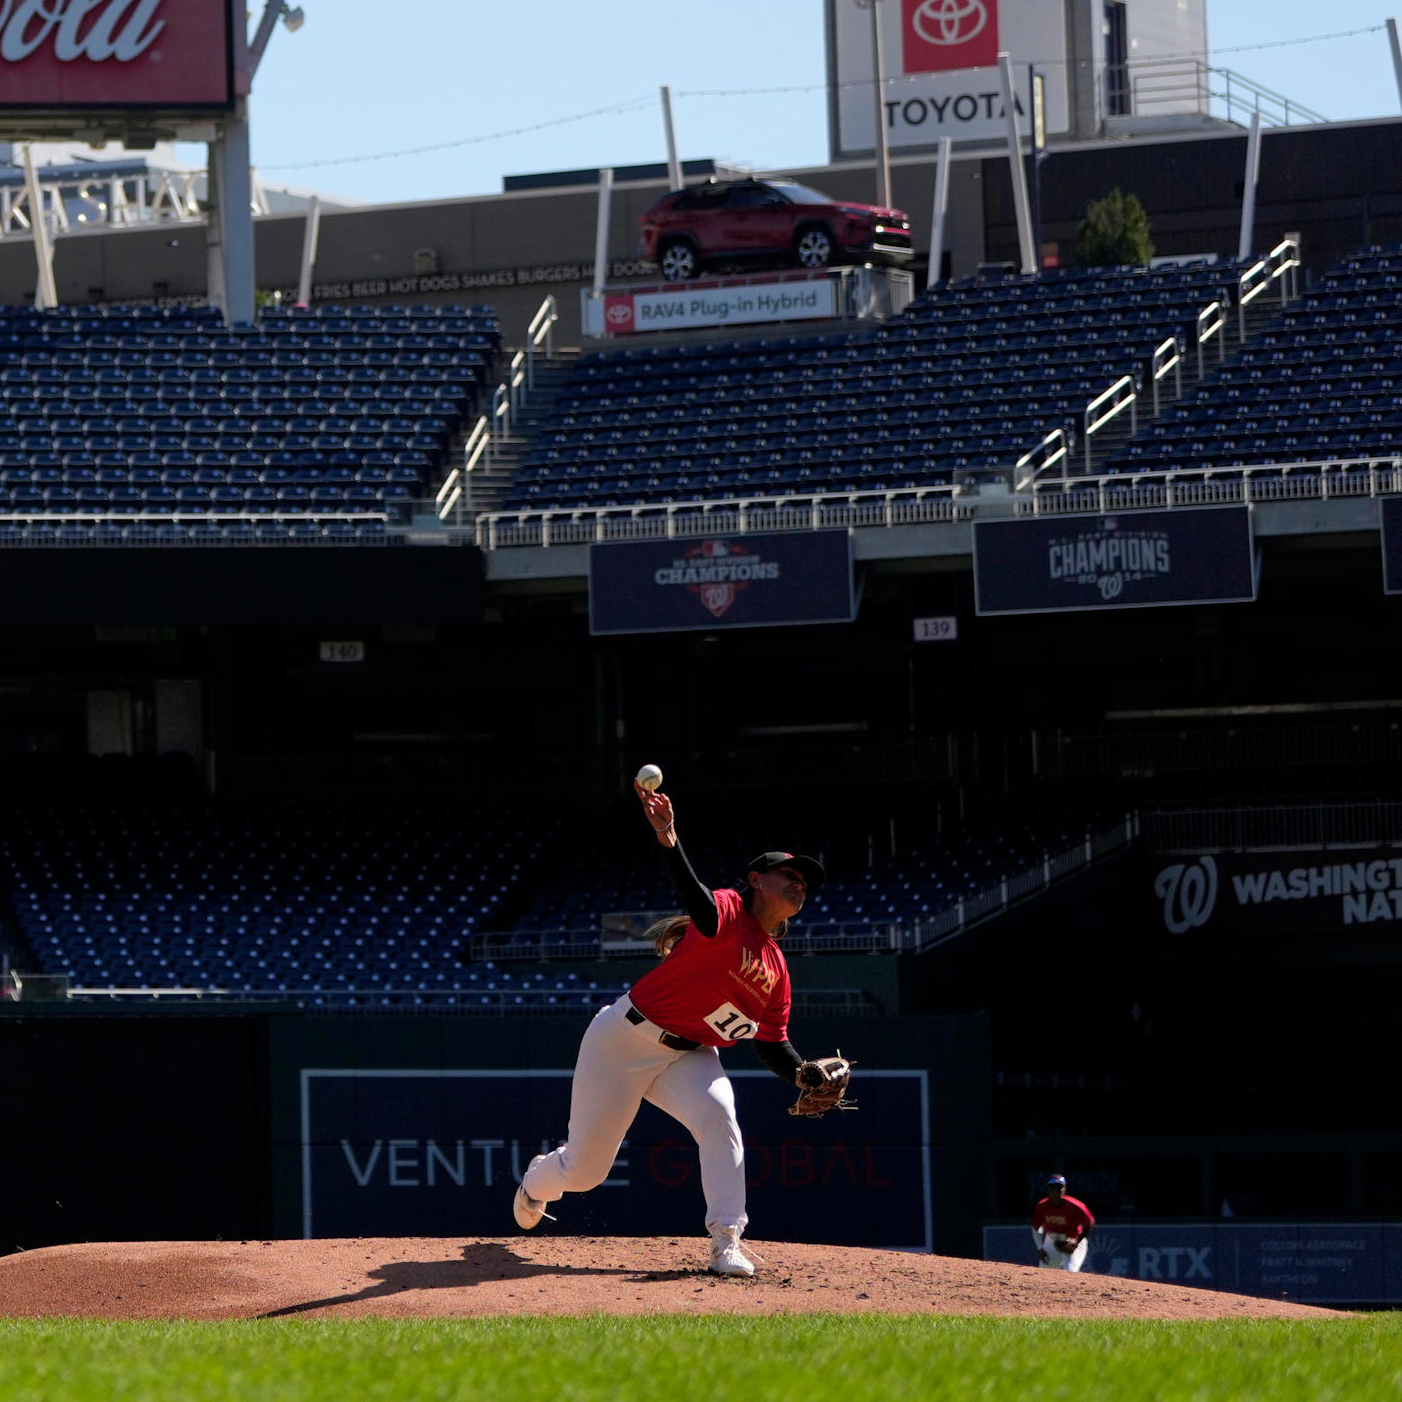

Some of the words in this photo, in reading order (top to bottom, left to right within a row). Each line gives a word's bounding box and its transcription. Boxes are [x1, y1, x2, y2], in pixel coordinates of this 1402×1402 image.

[884, 92, 1024, 127] TOYOTA
[517, 264, 580, 285] BURGERS
[582, 262, 612, 279] HT
[641, 302, 685, 320] RAV4
[690, 299, 753, 322] Plug-in
[757, 292, 817, 315] Hybrid
[1048, 538, 1170, 579] CHAMPIONS
[654, 562, 781, 586] CHAMPIONS
[922, 620, 950, 637] 139
[713, 1011, 751, 1039] 10
[647, 1138, 893, 1188] GOBAL
[1138, 1247, 1213, 1280] RTX
